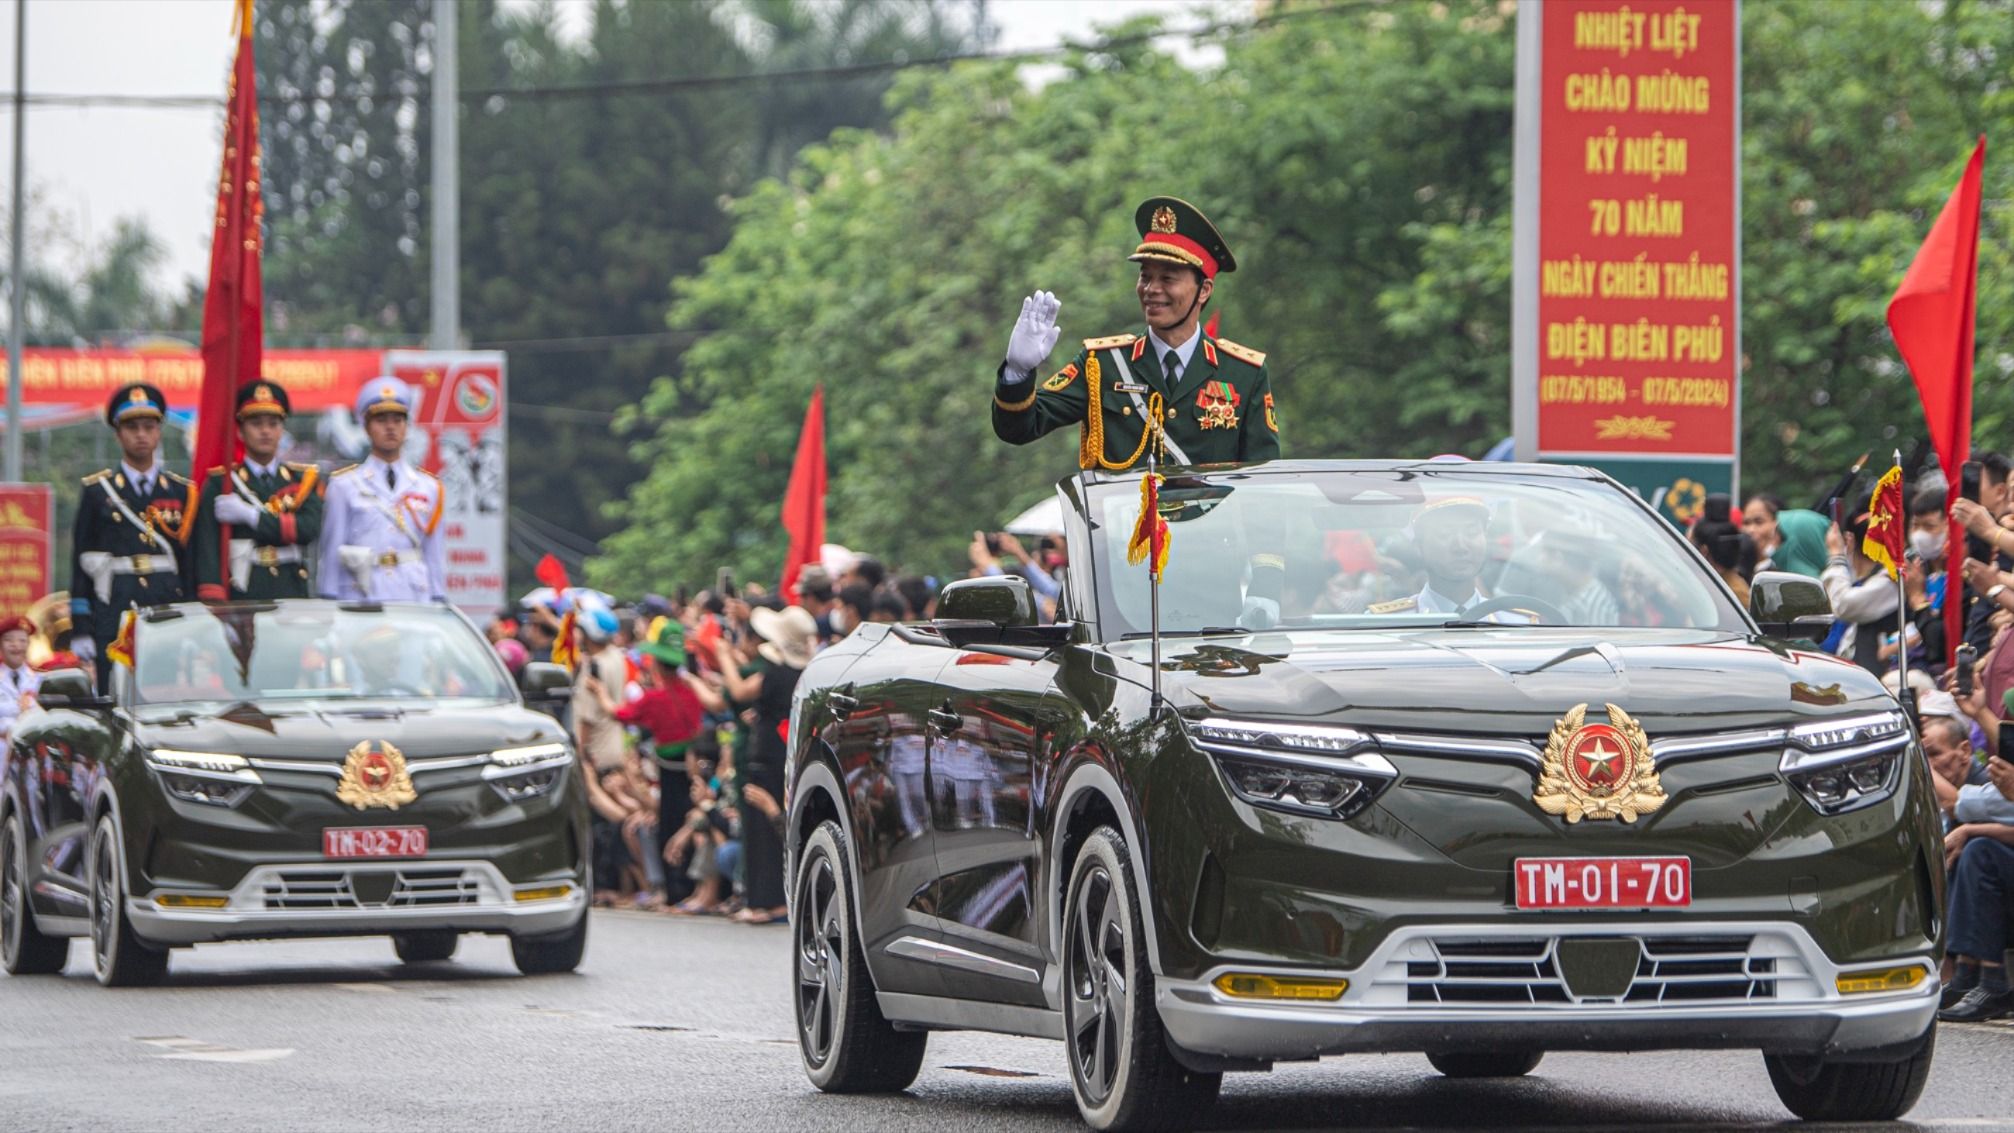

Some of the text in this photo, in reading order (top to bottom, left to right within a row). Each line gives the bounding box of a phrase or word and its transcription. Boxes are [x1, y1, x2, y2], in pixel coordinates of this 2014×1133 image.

[1574, 6, 1701, 58] NHIỆT LIỆT
[1565, 67, 1710, 114] CHÀO MỪNG
[1585, 126, 1688, 182] KỶ NIỆM
[1589, 194, 1684, 237] 70 NĂM
[1543, 251, 1729, 301] NGÀY CHIẾN THẮNG
[1547, 314, 1723, 367] ĐIỆN BIÊN PHỦ
[1541, 375, 1627, 404] (07/5/1954
[1642, 377, 1729, 408] 07/5/2024)
[326, 829, 425, 856] TM-02-70
[1521, 863, 1684, 904] TM-01-70
